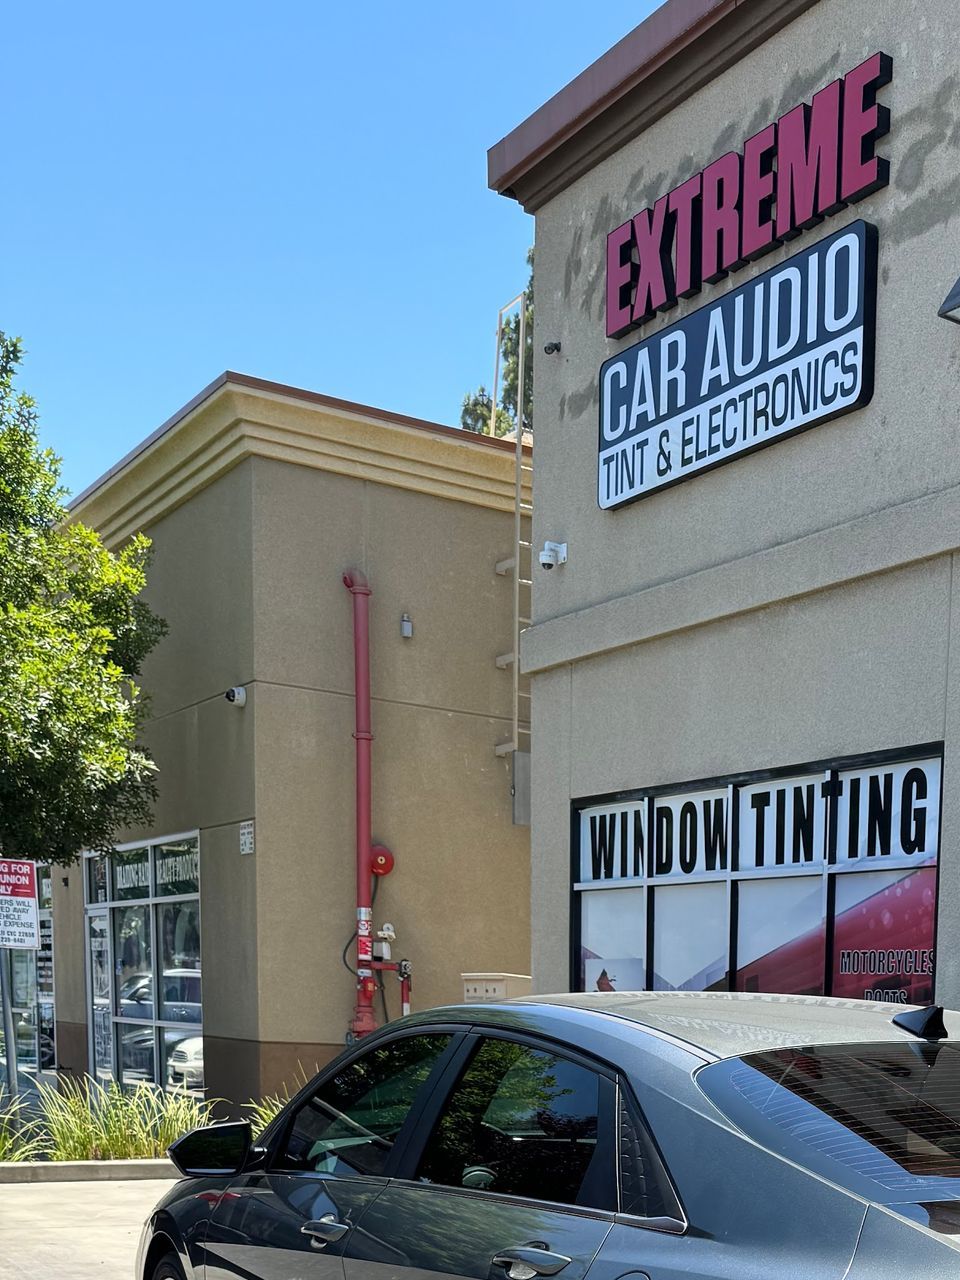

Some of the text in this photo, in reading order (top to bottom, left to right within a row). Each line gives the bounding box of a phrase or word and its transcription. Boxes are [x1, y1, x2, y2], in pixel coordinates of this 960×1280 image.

[606, 51, 892, 339] EXTREME
[603, 232, 861, 442] CAR AUDIO
[603, 341, 860, 500] TINT & ELECTRONICS
[590, 767, 928, 880] WINDOW TINTING
[11, 865, 31, 875] FOR
[1, 875, 29, 886] UNION
[13, 907, 30, 915] AWAY
[16, 900, 32, 908] WILL
[4, 921, 35, 929] EXPENSE
[840, 949, 934, 976] MOTORCYCLES
